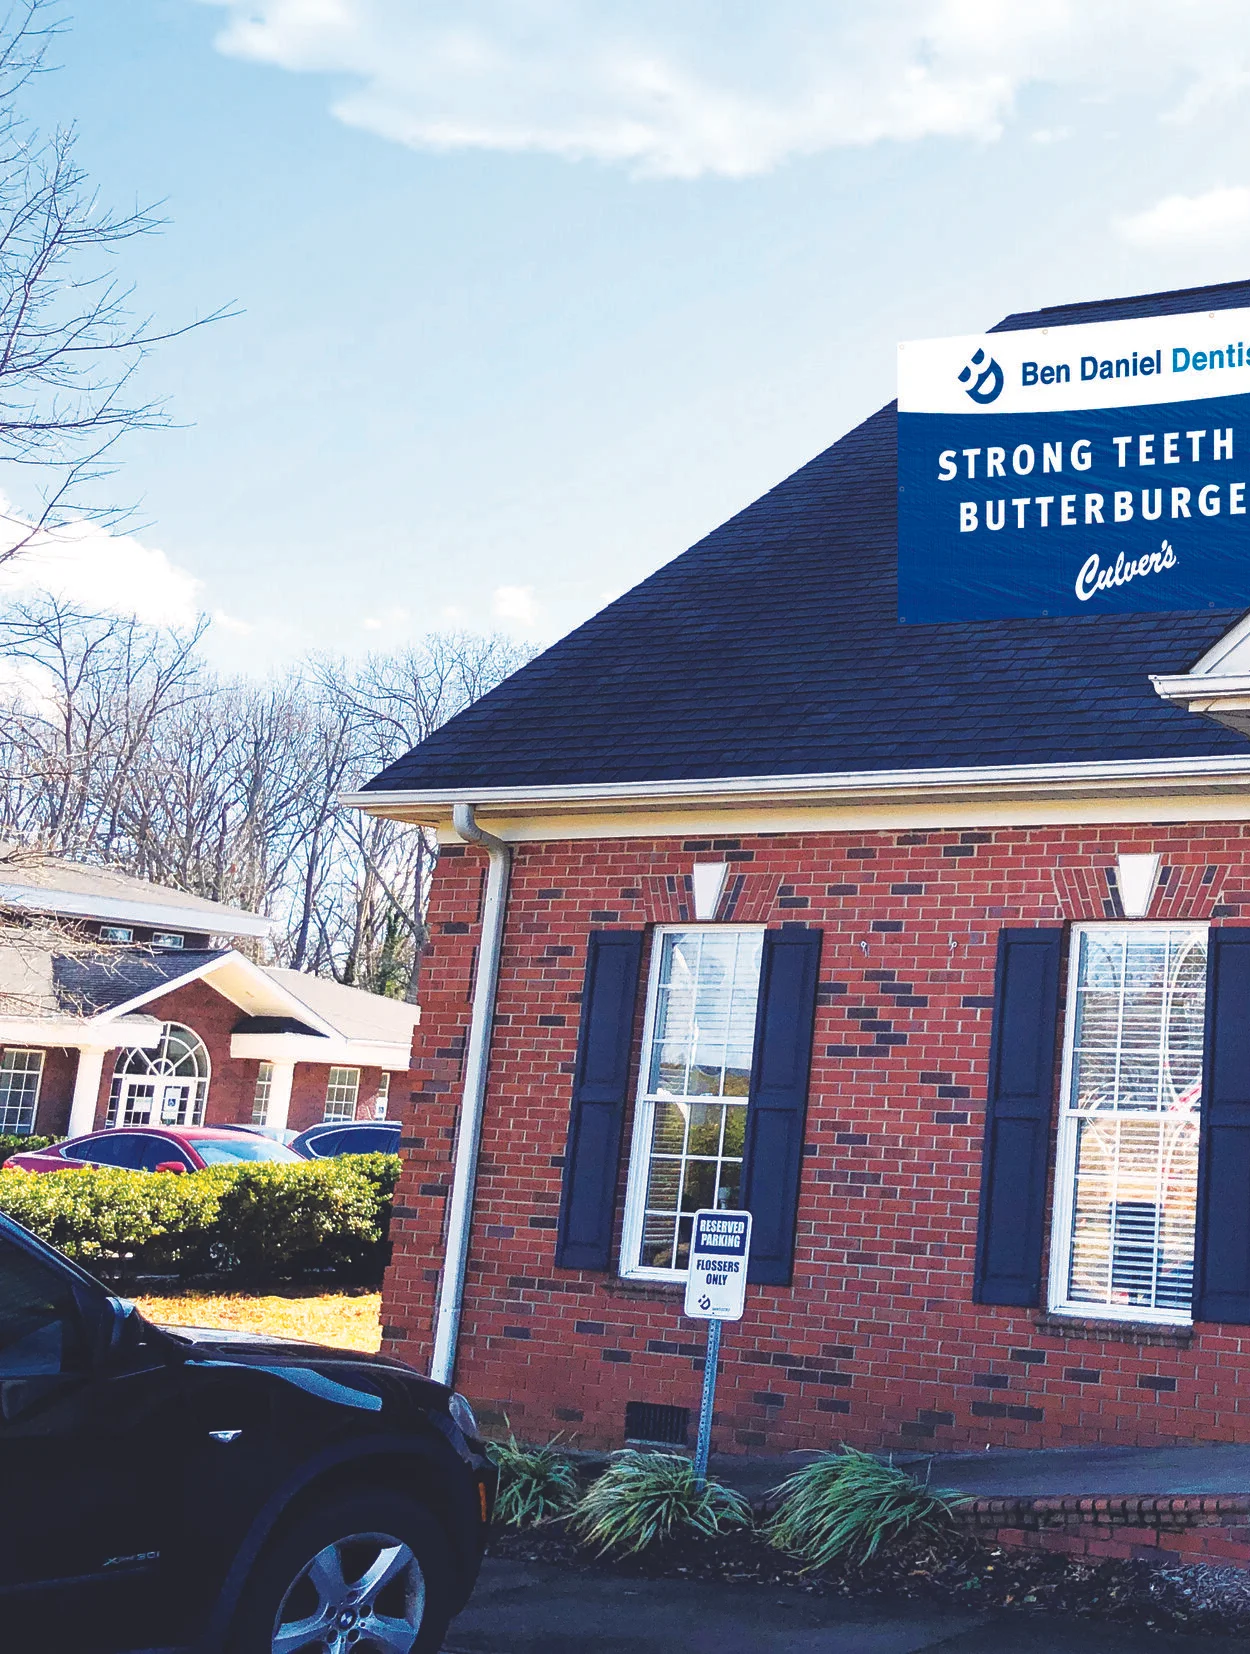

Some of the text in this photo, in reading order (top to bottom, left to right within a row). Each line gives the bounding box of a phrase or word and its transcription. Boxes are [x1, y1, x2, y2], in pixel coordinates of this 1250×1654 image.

[1022, 361, 1070, 387] Ben
[1080, 349, 1162, 381] Daniel
[937, 438, 1093, 482] STRONG
[1112, 427, 1234, 468] TEETH
[1074, 539, 1177, 602] Culver's
[699, 1219, 745, 1234] RESERVED
[700, 1233, 741, 1248] PARKING
[696, 1259, 740, 1273] FLOSSERS
[705, 1273, 729, 1286] ONLY
